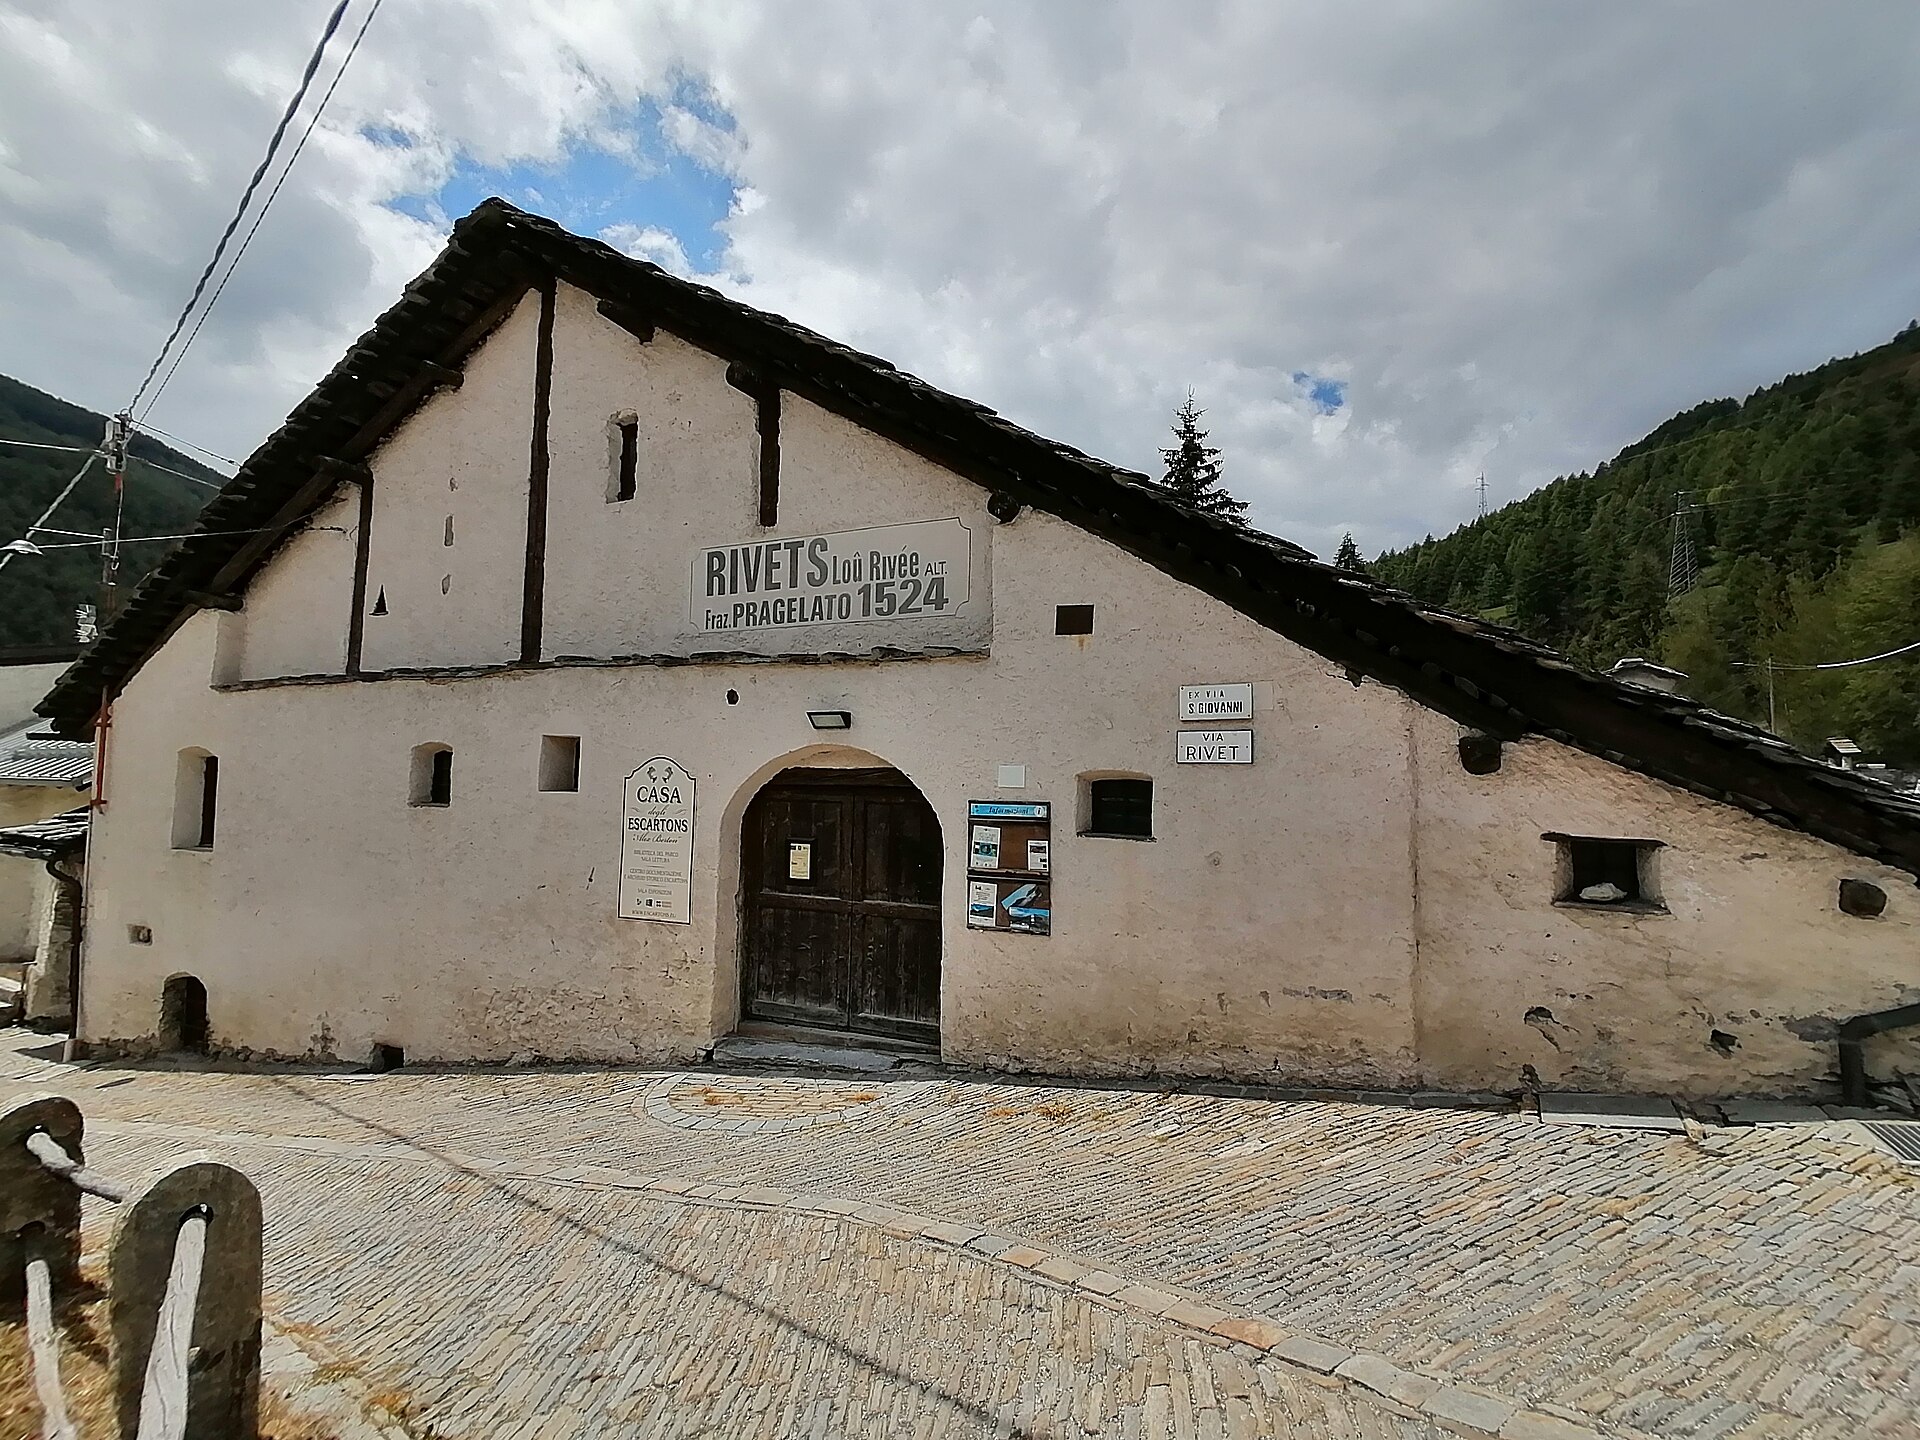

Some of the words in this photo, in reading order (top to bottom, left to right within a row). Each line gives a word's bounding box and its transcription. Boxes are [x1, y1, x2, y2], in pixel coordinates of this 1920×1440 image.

[706, 537, 829, 597] RIVETS
[832, 551, 862, 585] Loû
[924, 561, 948, 577] ALT.
[705, 609, 731, 630] Fraz.
[732, 593, 851, 629] PRAGELATO
[857, 576, 949, 617] 1524
[1188, 691, 1200, 699] EX
[1206, 690, 1225, 698] VIA
[1198, 701, 1243, 714] GIOVANNI
[1202, 732, 1224, 742] VIA
[1186, 745, 1239, 760] RIVET
[637, 786, 682, 804] CASA
[648, 804, 670, 818] degli
[628, 817, 688, 833] ESCARTONS
